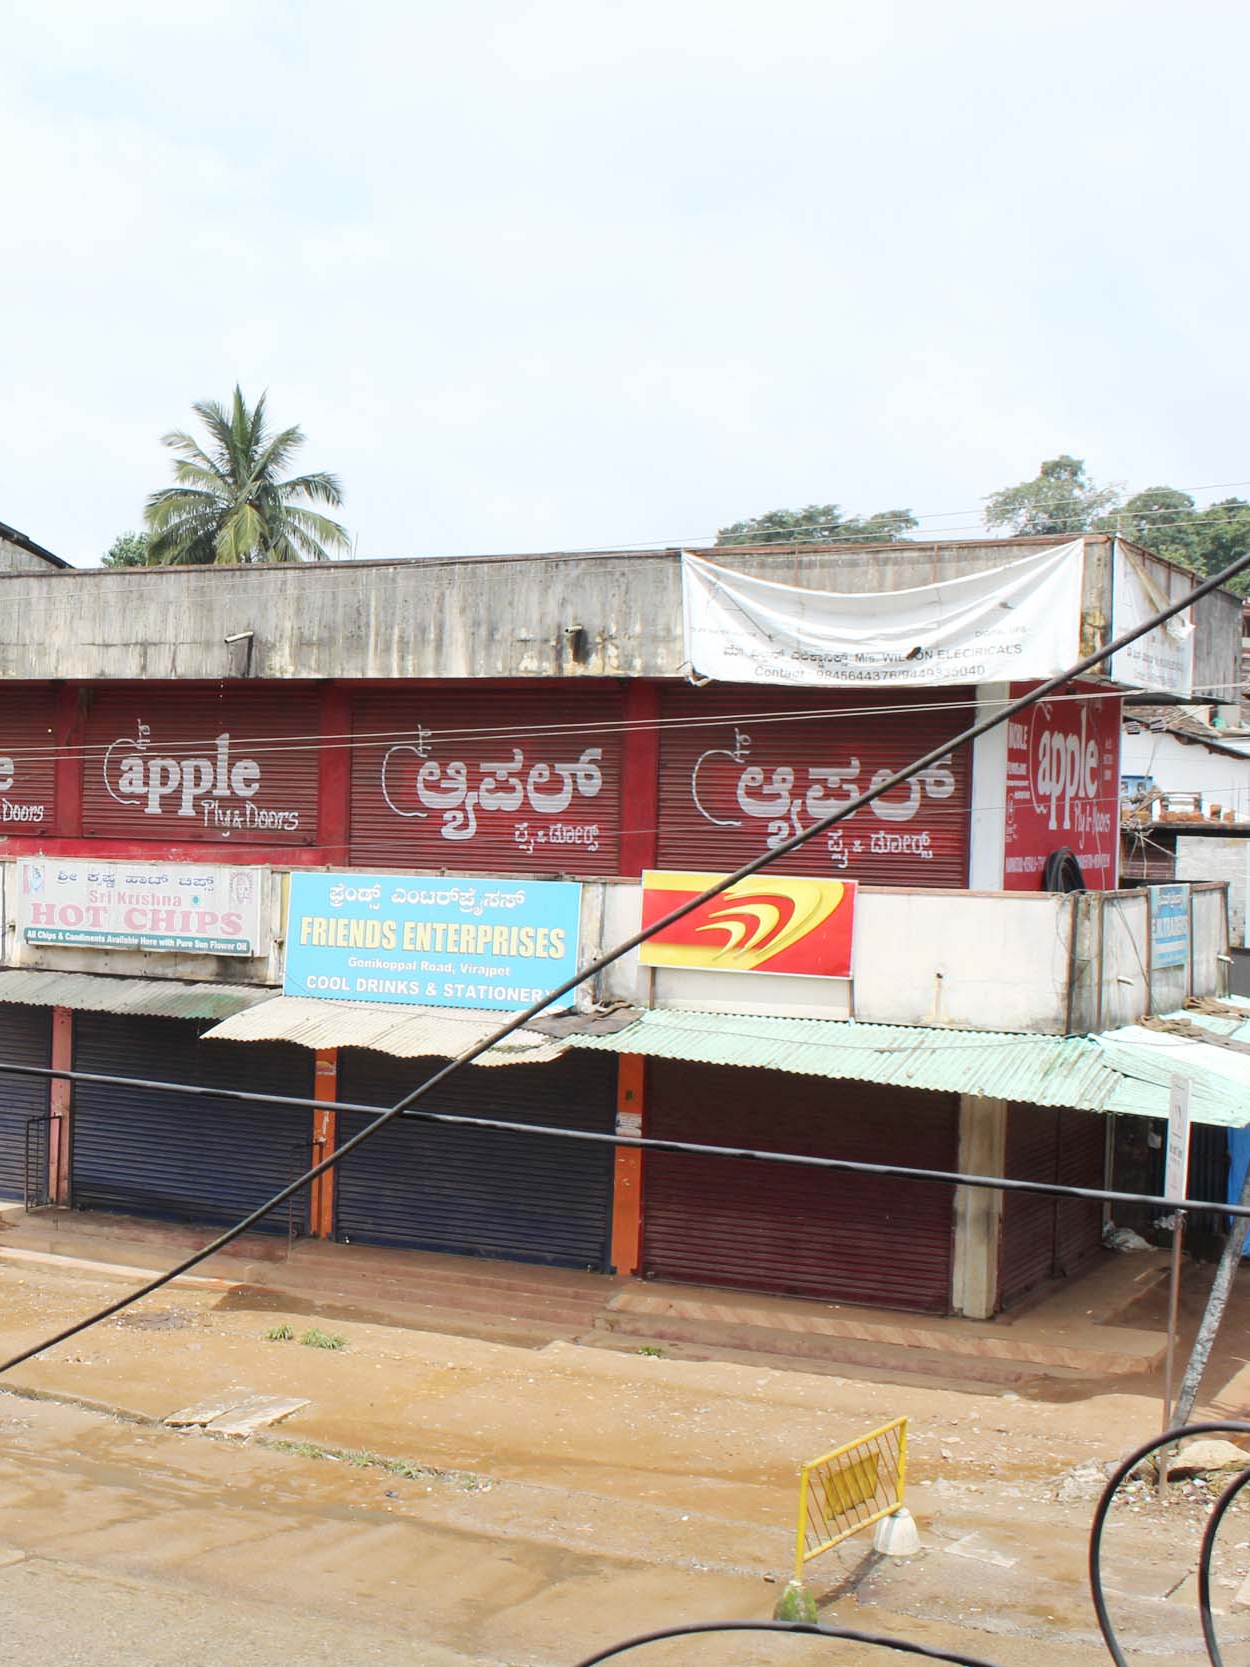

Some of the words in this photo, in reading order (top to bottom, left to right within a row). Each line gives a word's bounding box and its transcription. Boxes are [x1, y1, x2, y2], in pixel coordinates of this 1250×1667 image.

[882, 649, 934, 664] WILON
[118, 732, 261, 816] apple
[1037, 706, 1099, 831] apple
[2, 798, 44, 822] Doors
[200, 799, 230, 837] Ply
[245, 803, 299, 831] Doors
[89, 889, 110, 905] Sri
[117, 890, 182, 907] Krishna
[30, 902, 109, 928] HOT
[123, 907, 245, 936] CHIPS
[27, 930, 37, 939] All
[37, 931, 57, 942] Chips
[107, 934, 139, 946] Available
[140, 937, 158, 946] Here
[159, 937, 175, 947] with
[176, 938, 193, 948] Pure
[210, 940, 236, 951] Flower
[299, 916, 397, 951] FRIENDS
[402, 921, 567, 961] ENTERPRISES
[348, 956, 417, 973] Gonikoppal
[420, 960, 455, 976] Road,
[460, 961, 511, 978] Virajpet
[306, 974, 350, 992] COOL
[356, 978, 420, 996] DRINKS
[426, 982, 437, 997] &
